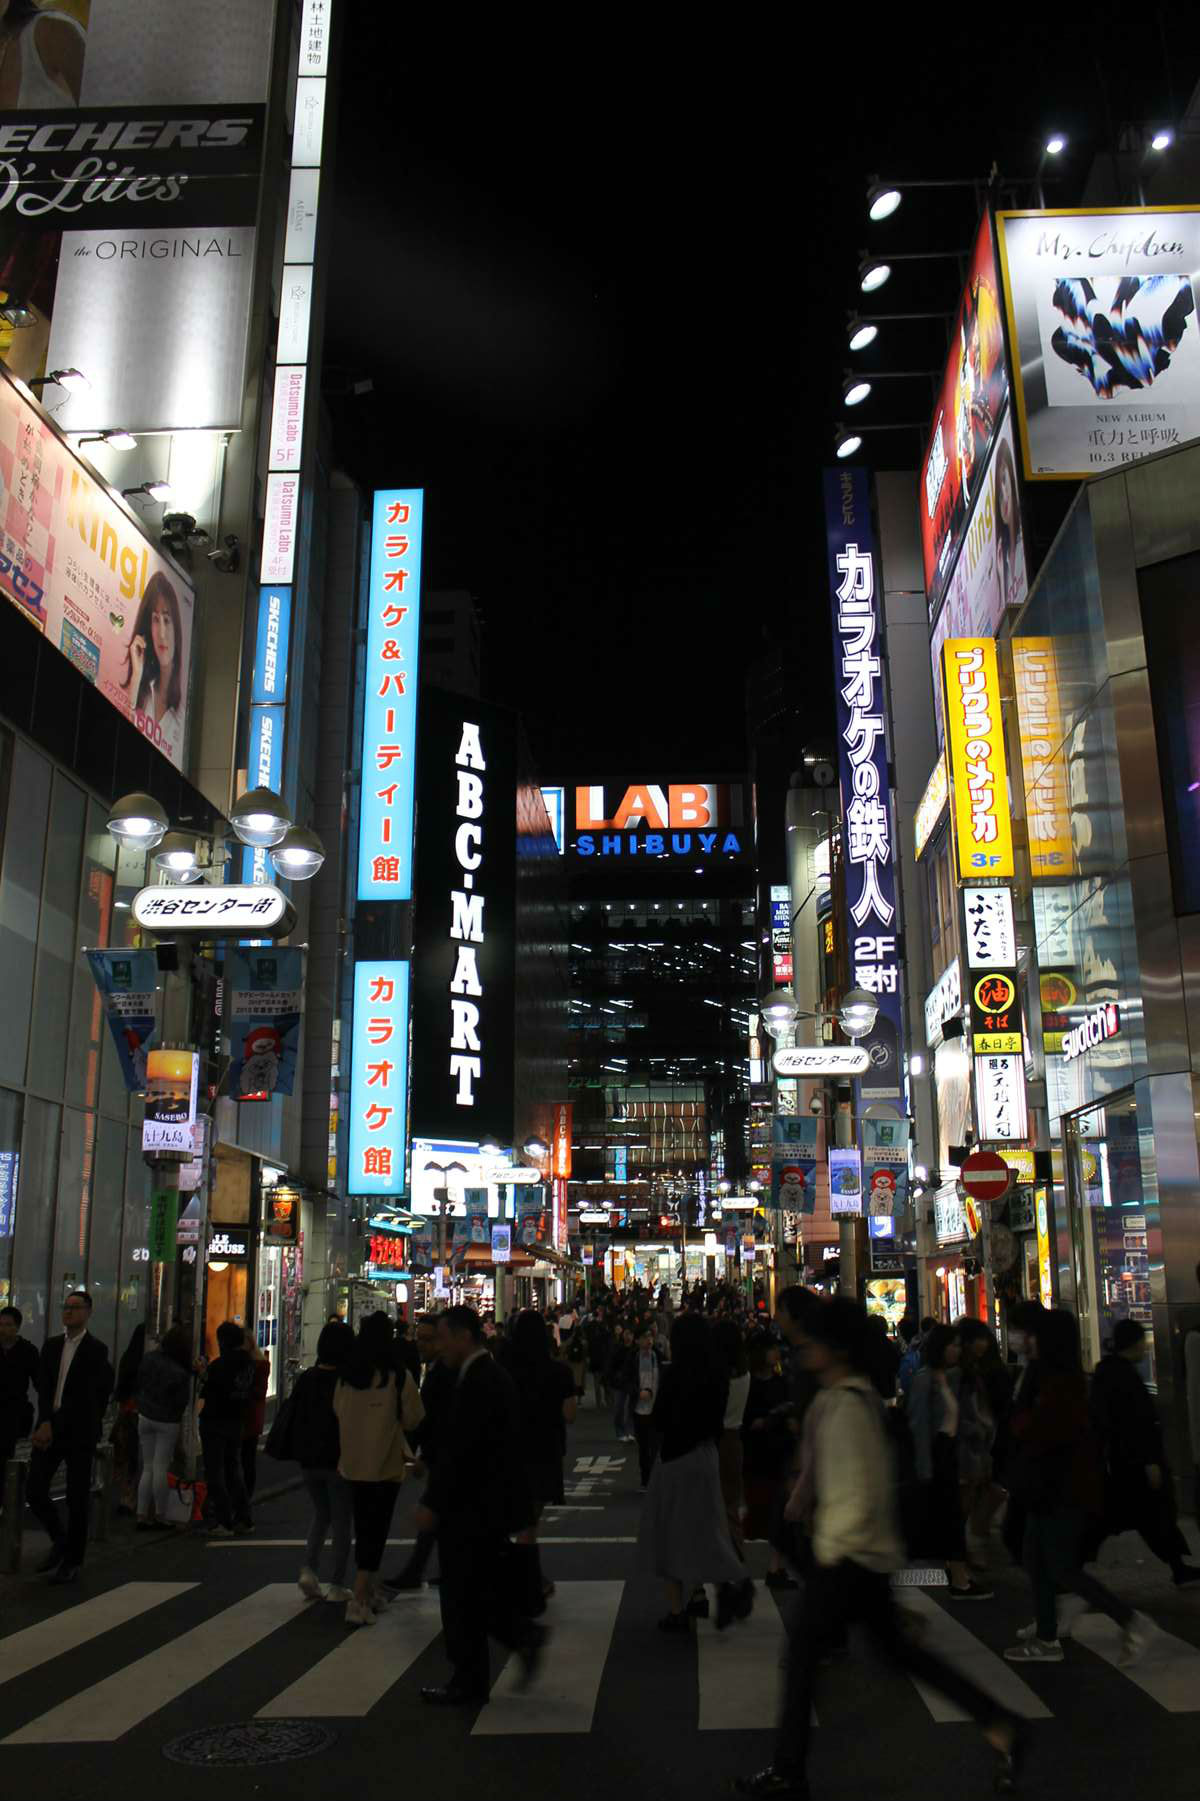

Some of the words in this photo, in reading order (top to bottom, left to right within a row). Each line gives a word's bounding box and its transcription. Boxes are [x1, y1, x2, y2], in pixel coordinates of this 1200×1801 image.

[96, 239, 242, 259] ORIGINAL
[1096, 414, 1121, 424] NEW
[1126, 412, 1166, 423] ALBUM
[1088, 427, 1181, 446] 重力と呼吸
[275, 448, 295, 462] 5F
[1089, 451, 1115, 463] 10.3
[263, 596, 281, 694] SKECHERS
[836, 543, 895, 927] カラオケの鉄人
[954, 647, 999, 844] プリクラのメッカ
[577, 832, 742, 856] SHIBUYA
[971, 853, 1002, 868] 3F
[141, 898, 276, 915] 渋谷センター街
[854, 935, 896, 961] 2F
[855, 964, 898, 993] 受付
[978, 979, 1009, 1008] 油
[983, 1014, 1010, 1031] そば
[977, 1036, 1018, 1051] 春日亭
[1062, 1006, 1109, 1062] swatch
[778, 1054, 866, 1067] 渋谷センター街
[363, 976, 395, 1176] カラオケ館
[154, 1111, 188, 1121] SASEBO
[209, 1244, 246, 1255] HOUSE
